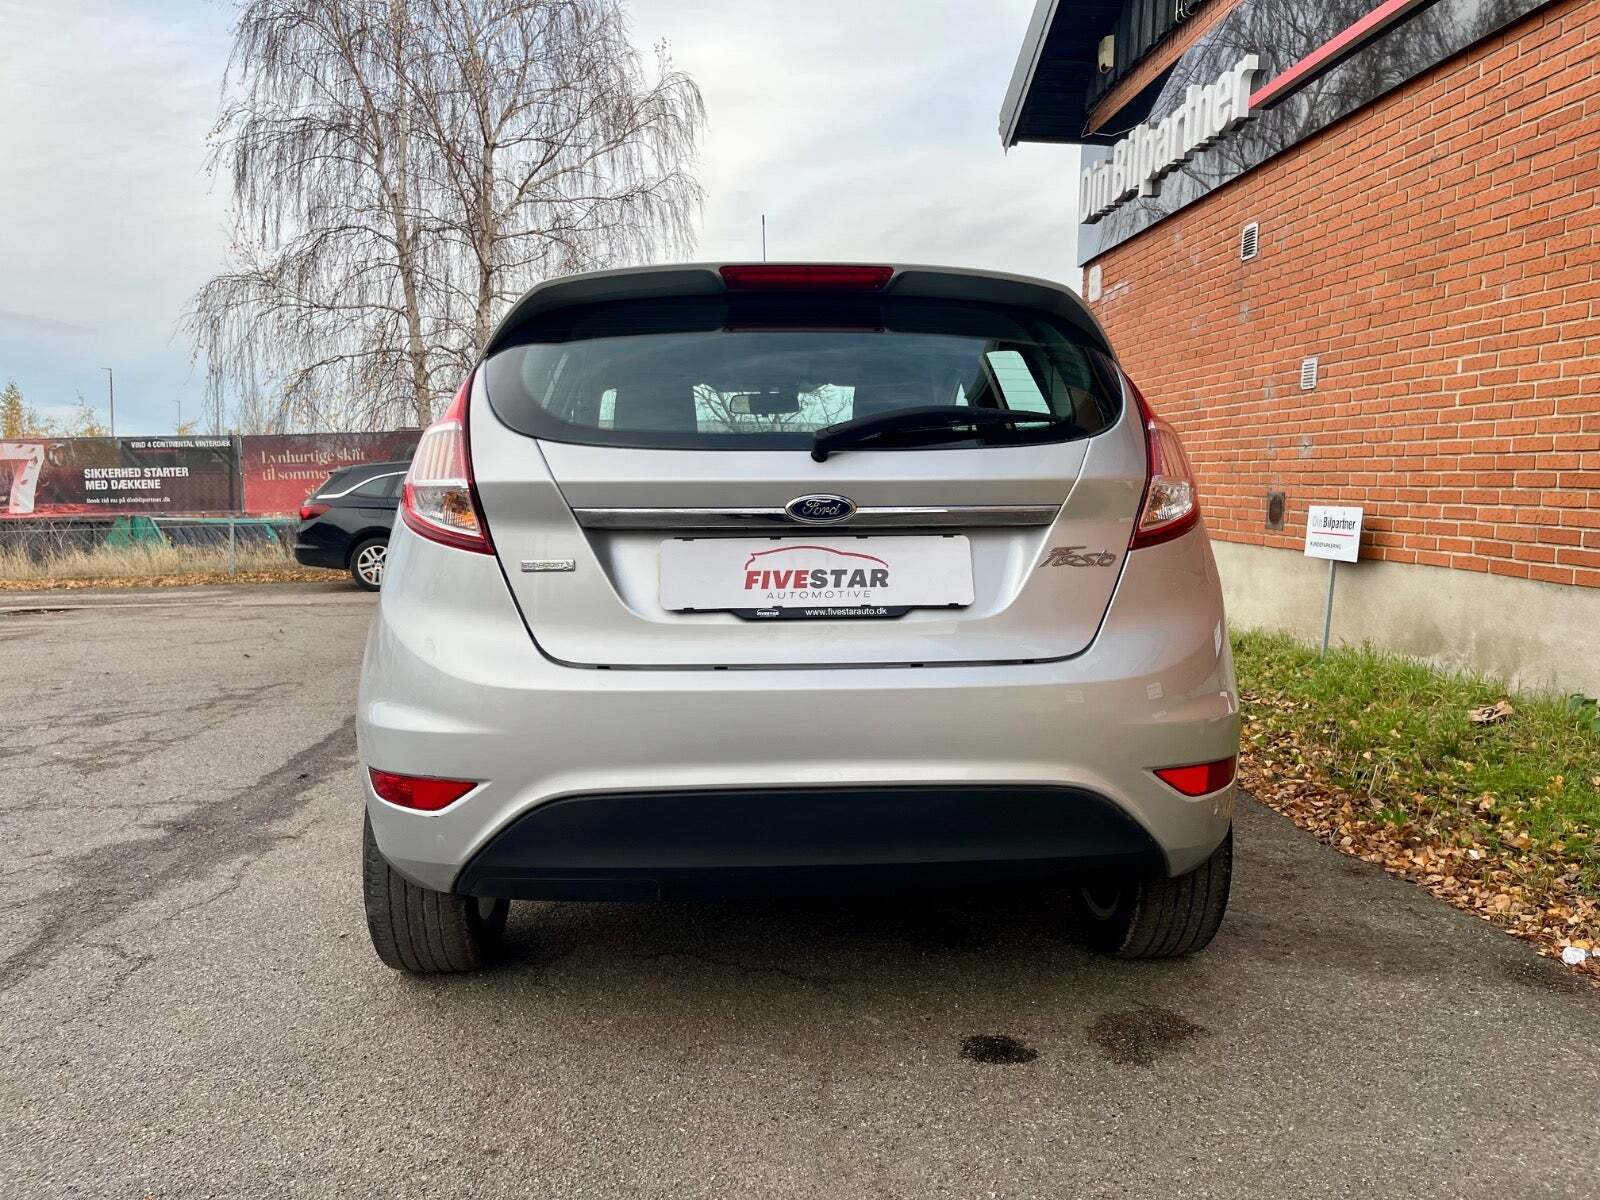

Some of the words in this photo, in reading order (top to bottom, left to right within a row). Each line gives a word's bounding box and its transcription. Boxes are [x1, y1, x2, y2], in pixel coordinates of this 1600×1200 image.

[152, 440, 194, 448] CONTINENTAL
[262, 450, 334, 465] Lynhurtige
[336, 447, 365, 461] skift
[84, 467, 142, 479] SIKKERHED
[144, 467, 189, 478] STARTER
[262, 465, 275, 480] til
[85, 480, 109, 490] MED
[111, 479, 161, 490] DÆKKENE
[119, 496, 126, 504] på
[802, 499, 840, 517] Ford
[744, 568, 889, 590] FIVESTAR
[766, 589, 872, 600] AUTOMOTIVE
[805, 607, 887, 617] www.fivestarauto.dk
